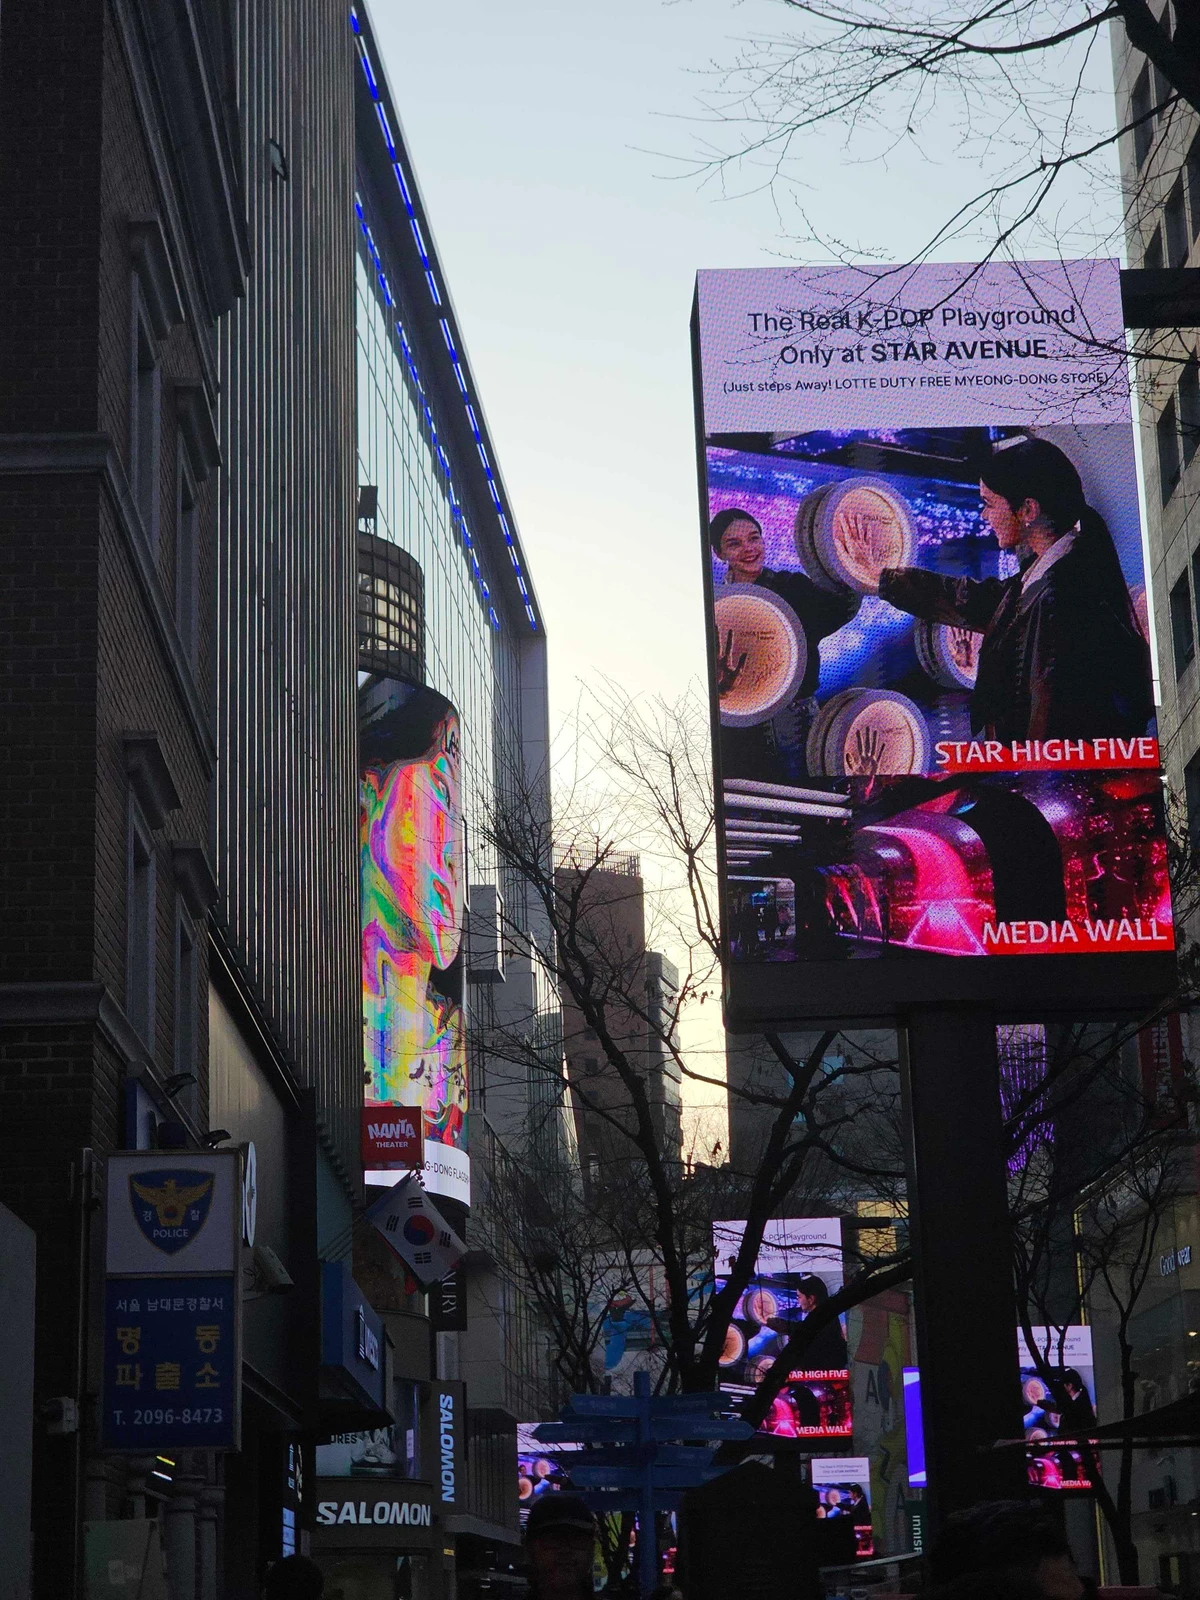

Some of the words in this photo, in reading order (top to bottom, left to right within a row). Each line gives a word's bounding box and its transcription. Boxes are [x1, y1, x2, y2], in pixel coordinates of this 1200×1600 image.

[747, 312, 793, 333] The
[798, 310, 852, 332] Real
[857, 307, 934, 330] K-POP
[941, 303, 1076, 335] Playground
[780, 344, 833, 369] Only
[840, 344, 865, 364] at
[870, 341, 938, 362] STAR
[944, 338, 1047, 360] AVENUE
[722, 379, 765, 395] (Just
[768, 379, 792, 394] steps
[795, 378, 832, 391] Away!
[835, 377, 877, 390] LOTTE
[880, 376, 916, 389] DUTY
[920, 375, 951, 388] FREE
[954, 372, 1058, 387] MYEONG-DONG
[1061, 371, 1109, 386] STORE)
[934, 740, 1002, 766] STAR
[1011, 738, 1085, 764] HIGH
[1093, 736, 1155, 761] FIVE
[982, 921, 1078, 946] MEDIA
[1084, 918, 1167, 943] WALL
[367, 1118, 416, 1140] NANTA
[375, 1141, 409, 1149] THEATER
[424, 1161, 453, 1178] G-DONG
[142, 1210, 153, 1222] 경
[190, 1210, 200, 1221] 찰
[152, 1228, 189, 1239] POLICE
[786, 1232, 827, 1241] Playground
[115, 1298, 141, 1313] 서울
[146, 1296, 224, 1312] 남대문경찰서
[805, 1369, 828, 1379] HIGH
[829, 1368, 848, 1378] FIVE
[113, 1410, 126, 1426] T.
[133, 1407, 223, 1426] 2096-8473
[795, 1425, 825, 1435] MEDIA
[825, 1424, 850, 1434] WALL
[438, 1392, 456, 1504] SALOMON
[315, 1500, 432, 1528] SALOMON
